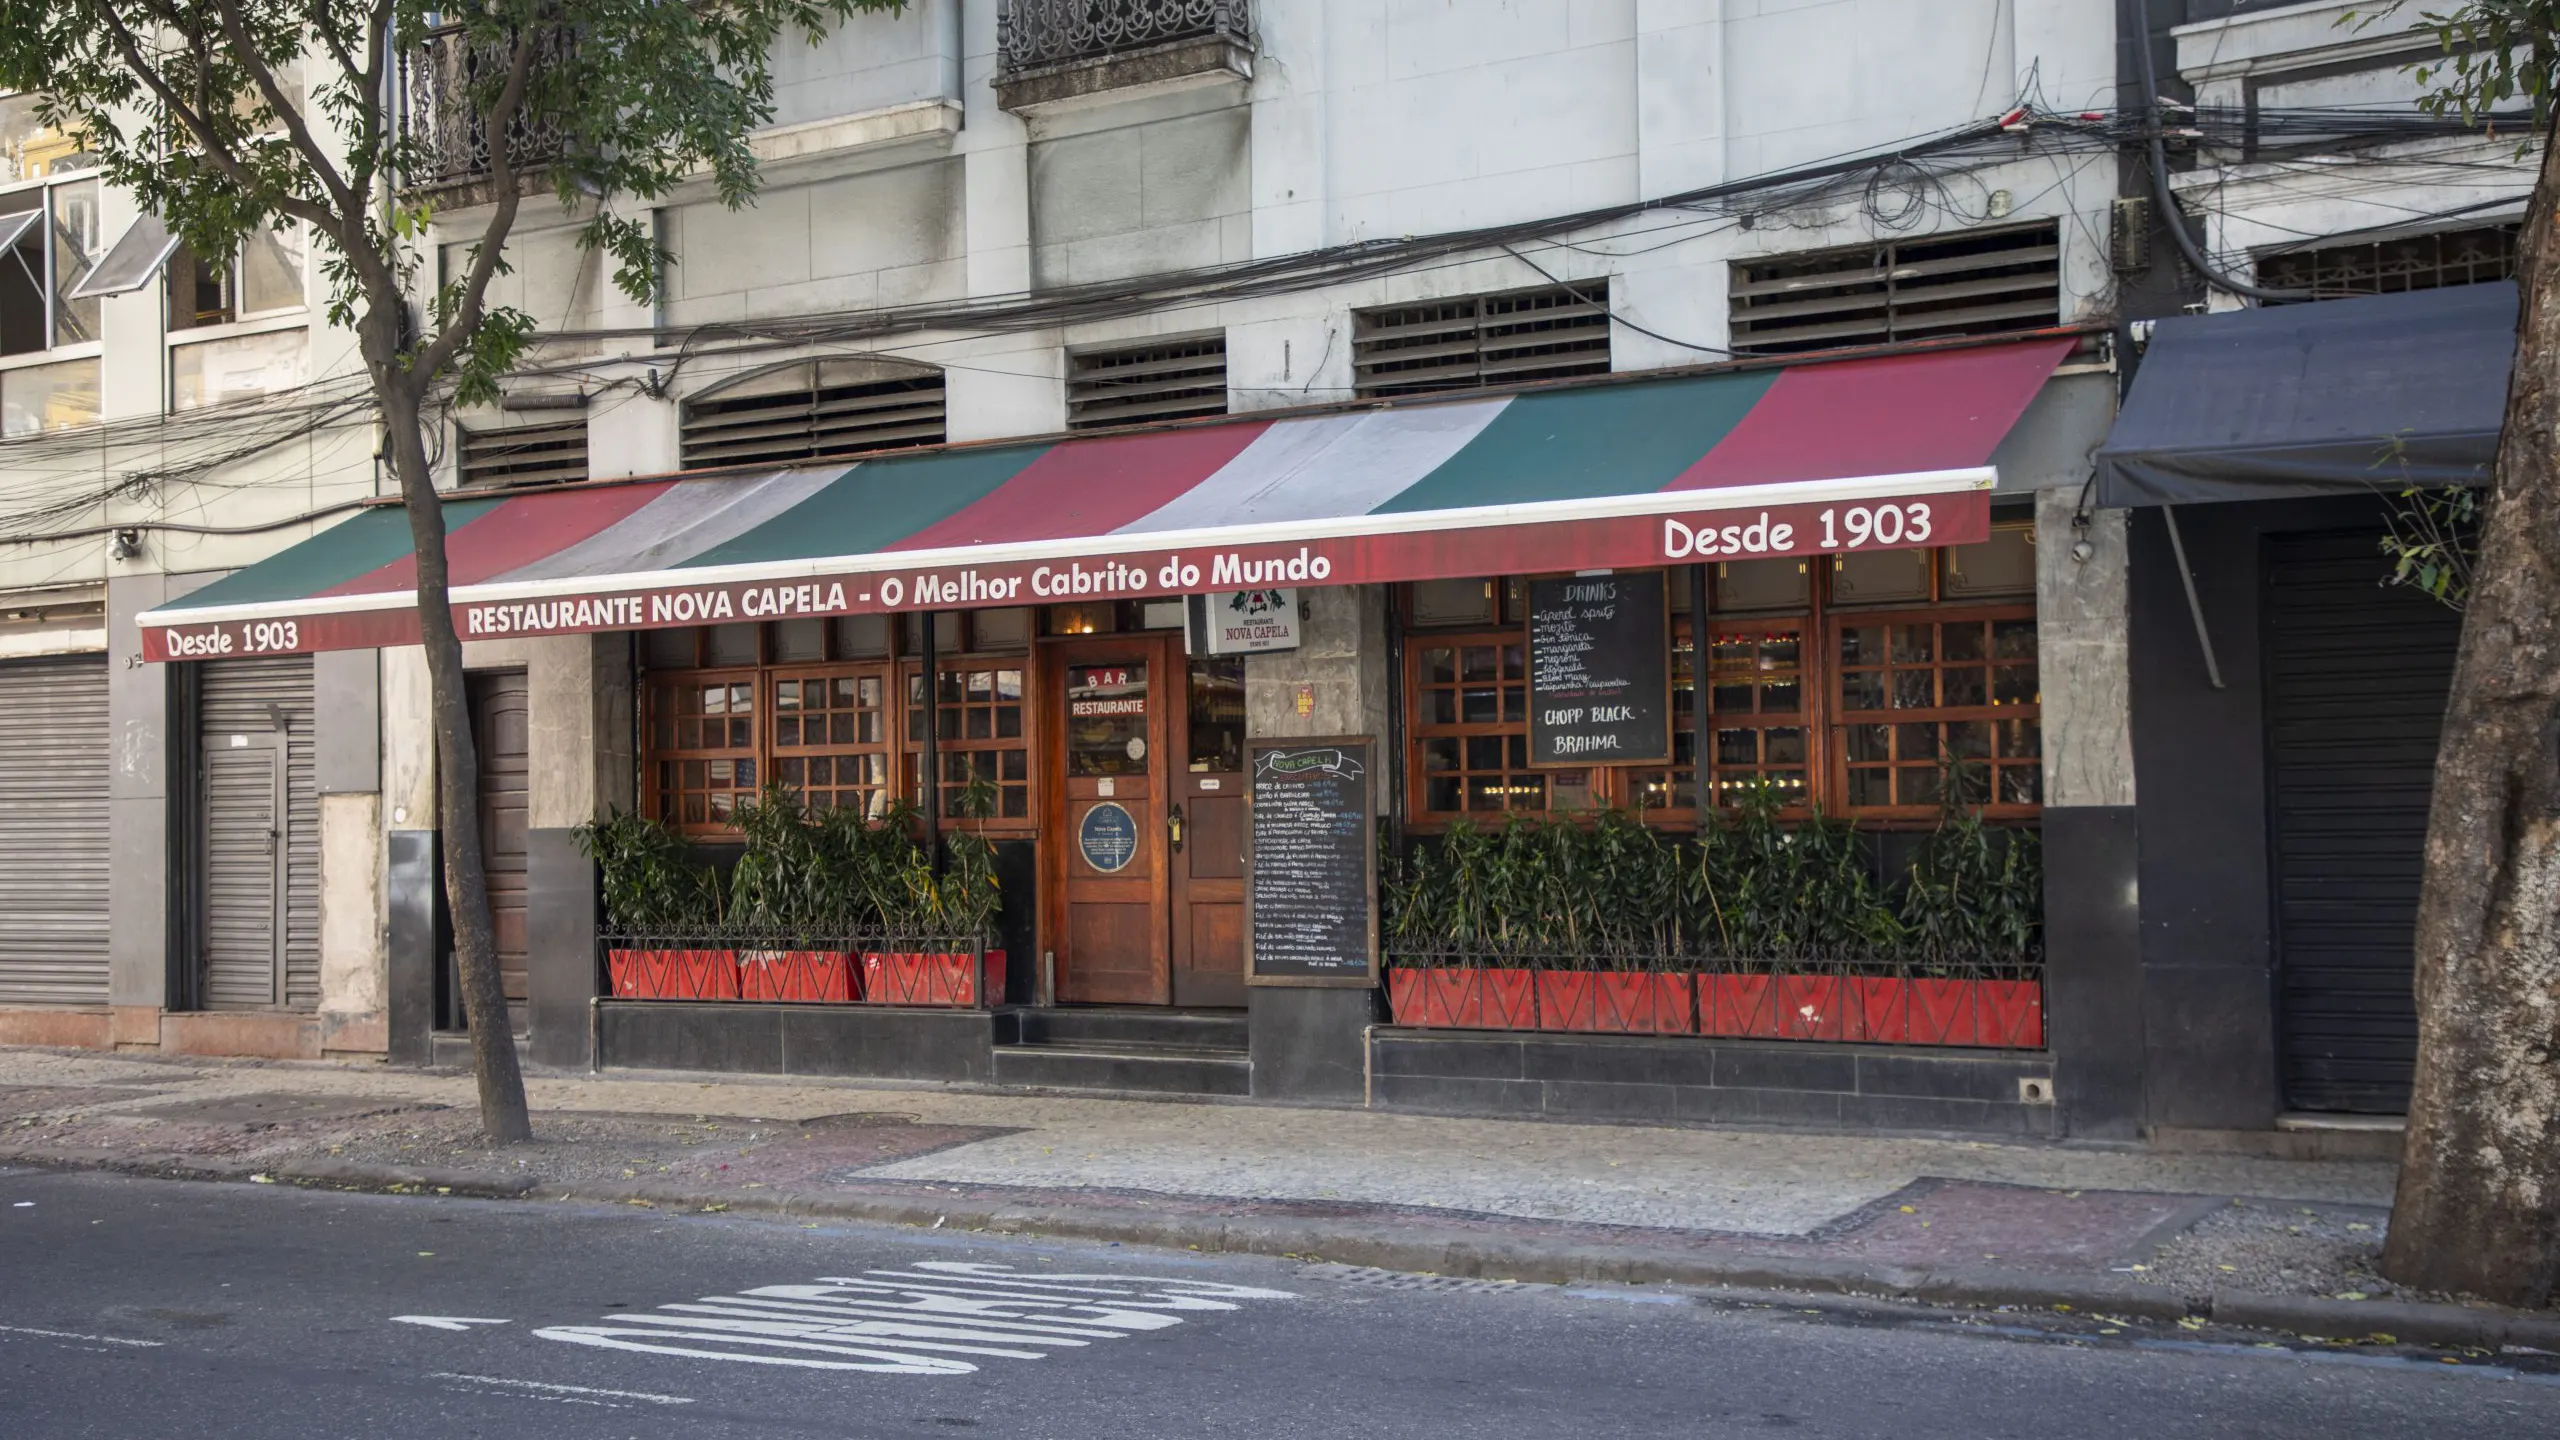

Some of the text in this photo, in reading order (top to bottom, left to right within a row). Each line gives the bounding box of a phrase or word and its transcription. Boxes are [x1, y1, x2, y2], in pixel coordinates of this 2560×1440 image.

[1664, 503, 1932, 558] Desde 1903
[468, 596, 643, 634] RESTAURANTE
[652, 589, 733, 622] NOVA
[741, 582, 847, 616] CAPELA
[881, 577, 903, 606] O
[914, 569, 1021, 604] Melhor
[1031, 560, 1147, 596] Cabrito
[1159, 555, 1200, 588] do
[1211, 547, 1331, 585] Mundo
[1563, 582, 1616, 602] DRINKS
[1243, 618, 1274, 626] RESTAURANTE
[166, 621, 298, 657] Desde 1903
[1226, 625, 1289, 640] NOVA CAPELA
[1087, 671, 1127, 688] BAR
[1072, 700, 1144, 715] RESTAURANTE
[1545, 706, 1636, 725] CHOPP BLACK
[1553, 735, 1622, 754] BRAHMA
[1273, 758, 1295, 769] NOVA
